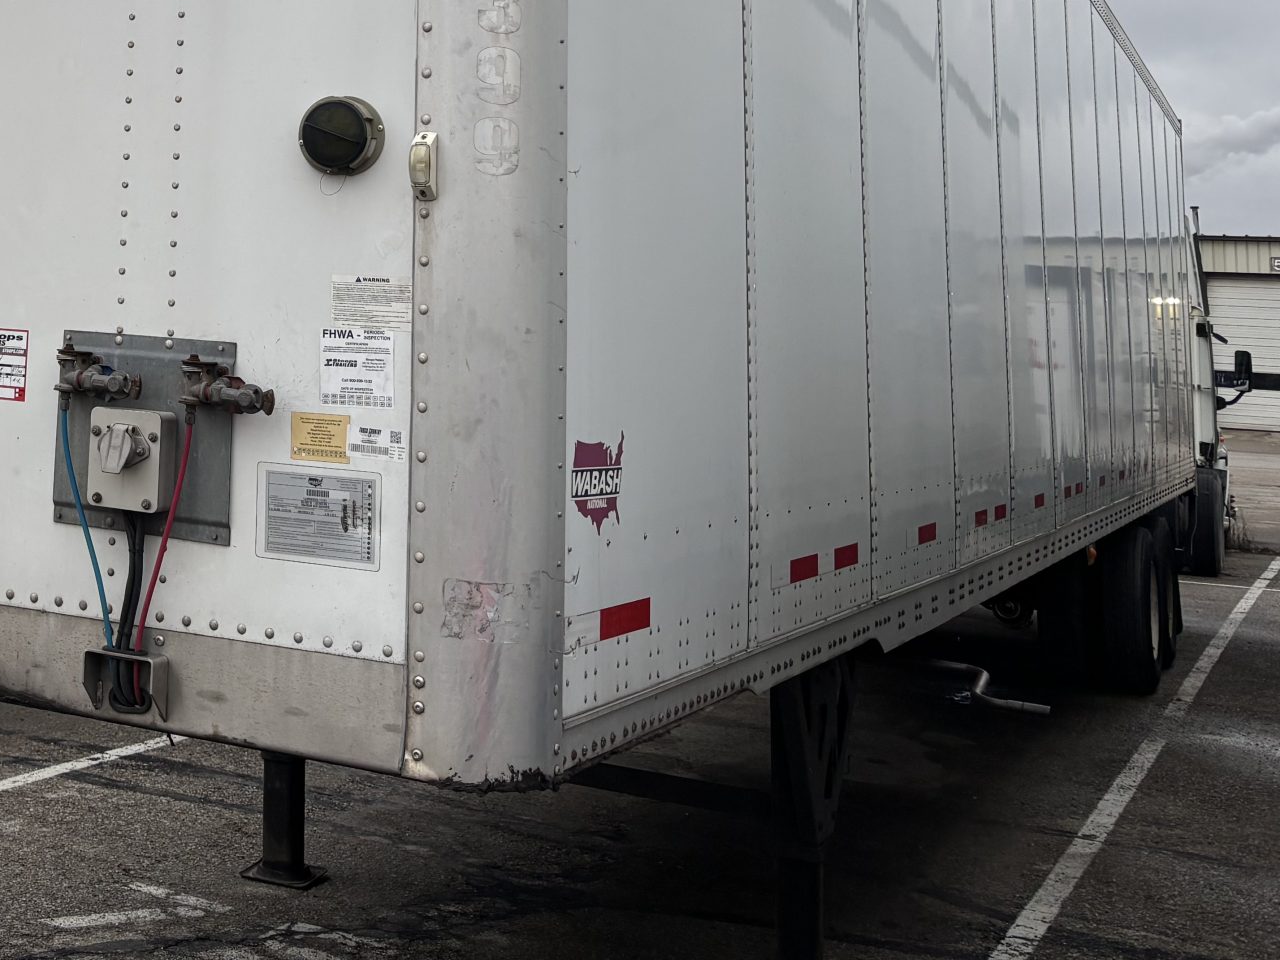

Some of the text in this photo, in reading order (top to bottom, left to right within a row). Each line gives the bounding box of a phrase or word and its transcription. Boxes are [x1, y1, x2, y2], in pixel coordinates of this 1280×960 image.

[322, 328, 354, 339] FHWA
[572, 467, 621, 497] WABASH
[586, 497, 608, 510] NATIONAL
